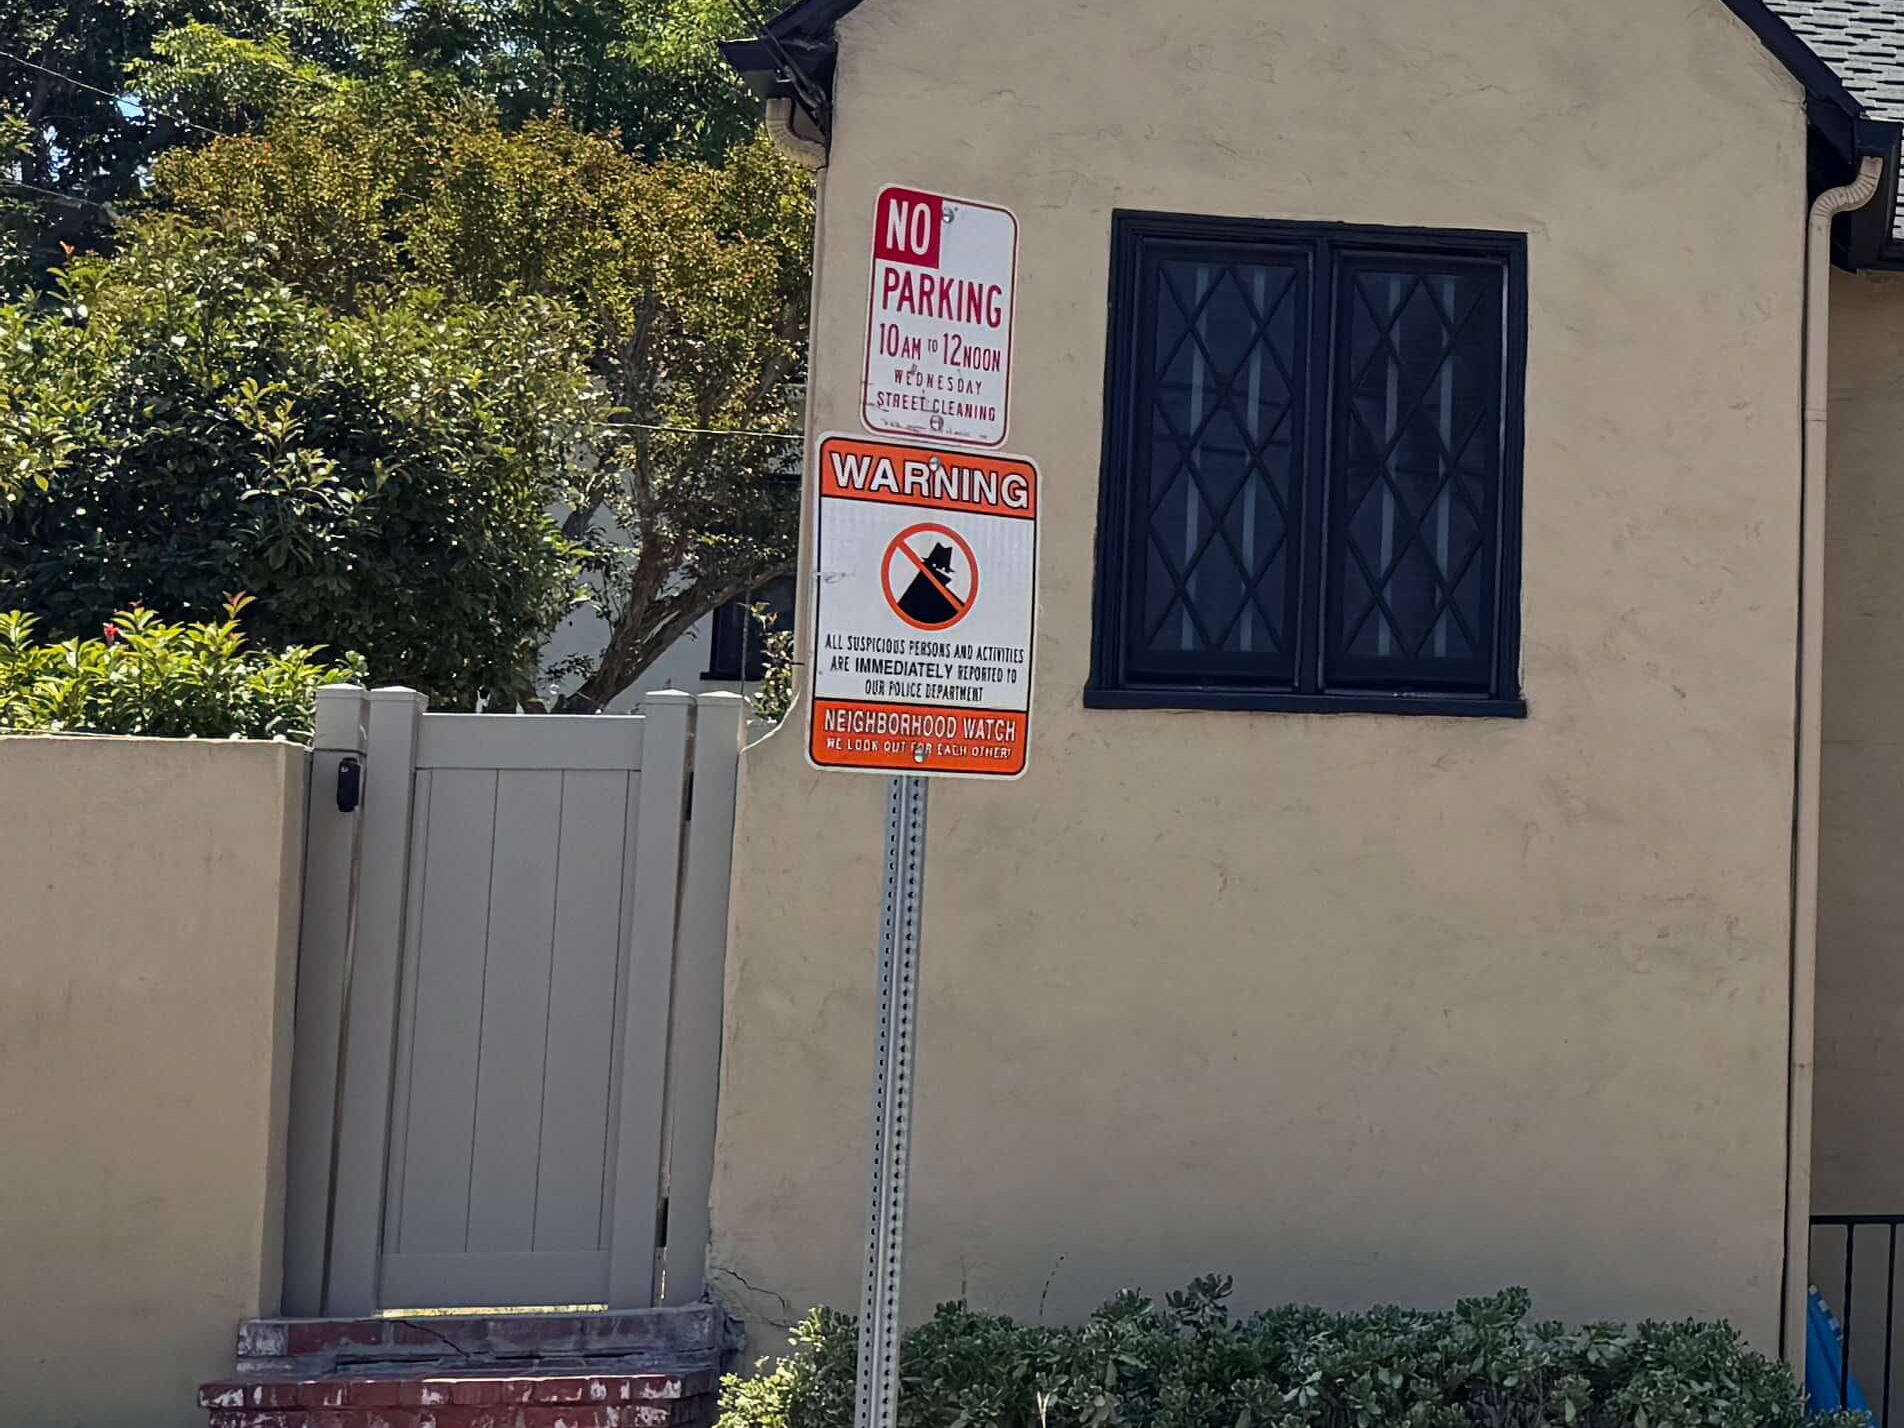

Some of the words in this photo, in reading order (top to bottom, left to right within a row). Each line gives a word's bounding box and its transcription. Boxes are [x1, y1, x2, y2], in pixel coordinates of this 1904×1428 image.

[886, 198, 931, 255] NO
[882, 267, 1002, 328] PARKING
[927, 338, 938, 353] TO
[894, 369, 982, 395] WEDNESDAY
[877, 391, 926, 411] STREET
[932, 401, 996, 421] CLEANING
[831, 452, 1029, 509] WARNING
[825, 633, 843, 650] ALL
[847, 635, 905, 655] SUSPICIOUS
[909, 640, 951, 659] PERSONS
[953, 643, 973, 661] AND
[976, 646, 1025, 664] ACTIVITIES
[830, 655, 850, 672] ARE
[855, 657, 953, 679] IMMEDIATELY
[957, 665, 1003, 683] REPORTED
[1005, 668, 1017, 684] TO
[865, 679, 885, 696] OUR
[888, 683, 922, 699] POLICE
[925, 684, 984, 702] DEPARTMENT
[824, 708, 957, 739] NEIGHBORHOOD
[963, 717, 1016, 743] WATCH
[826, 737, 842, 750] WE
[847, 739, 879, 753] LOOK
[884, 742, 905, 754] OUT
[937, 745, 967, 756] EACH
